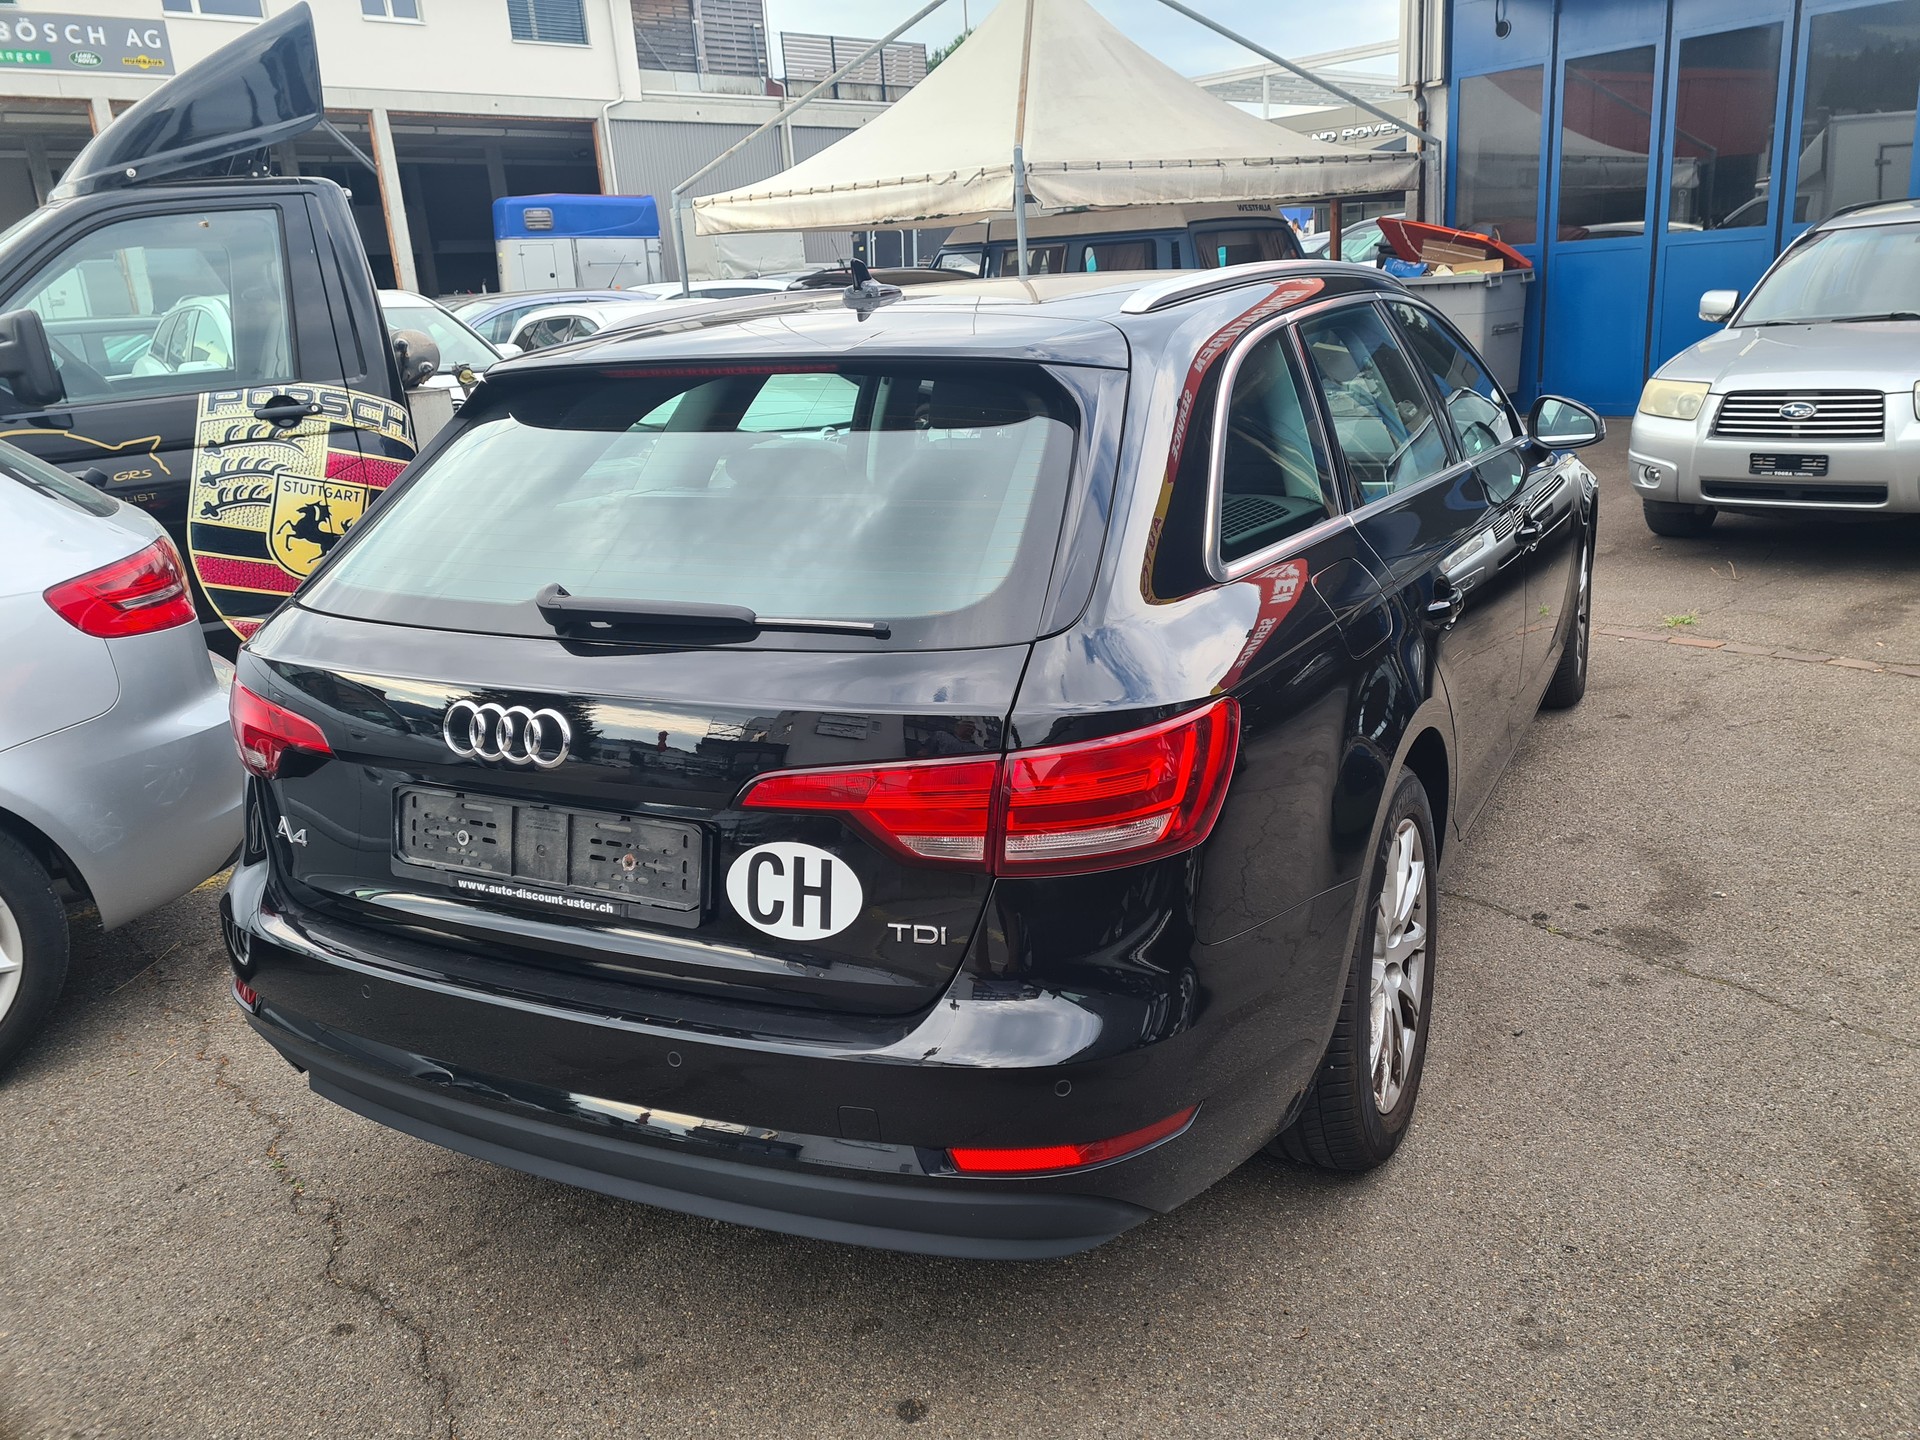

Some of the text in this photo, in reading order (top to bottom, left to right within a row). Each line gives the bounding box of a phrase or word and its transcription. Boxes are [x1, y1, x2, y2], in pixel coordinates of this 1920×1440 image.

[126, 28, 162, 48] AG
[1237, 203, 1272, 212] WESTFALIA
[207, 386, 414, 440] PORSCH
[113, 469, 153, 482] GRS
[123, 492, 158, 503] LIST
[283, 480, 362, 502] STUTTGART
[275, 815, 308, 847] A4
[457, 879, 614, 914] www.auto-discount-uster.ch
[747, 851, 832, 930] CH
[887, 922, 948, 945] TDI
